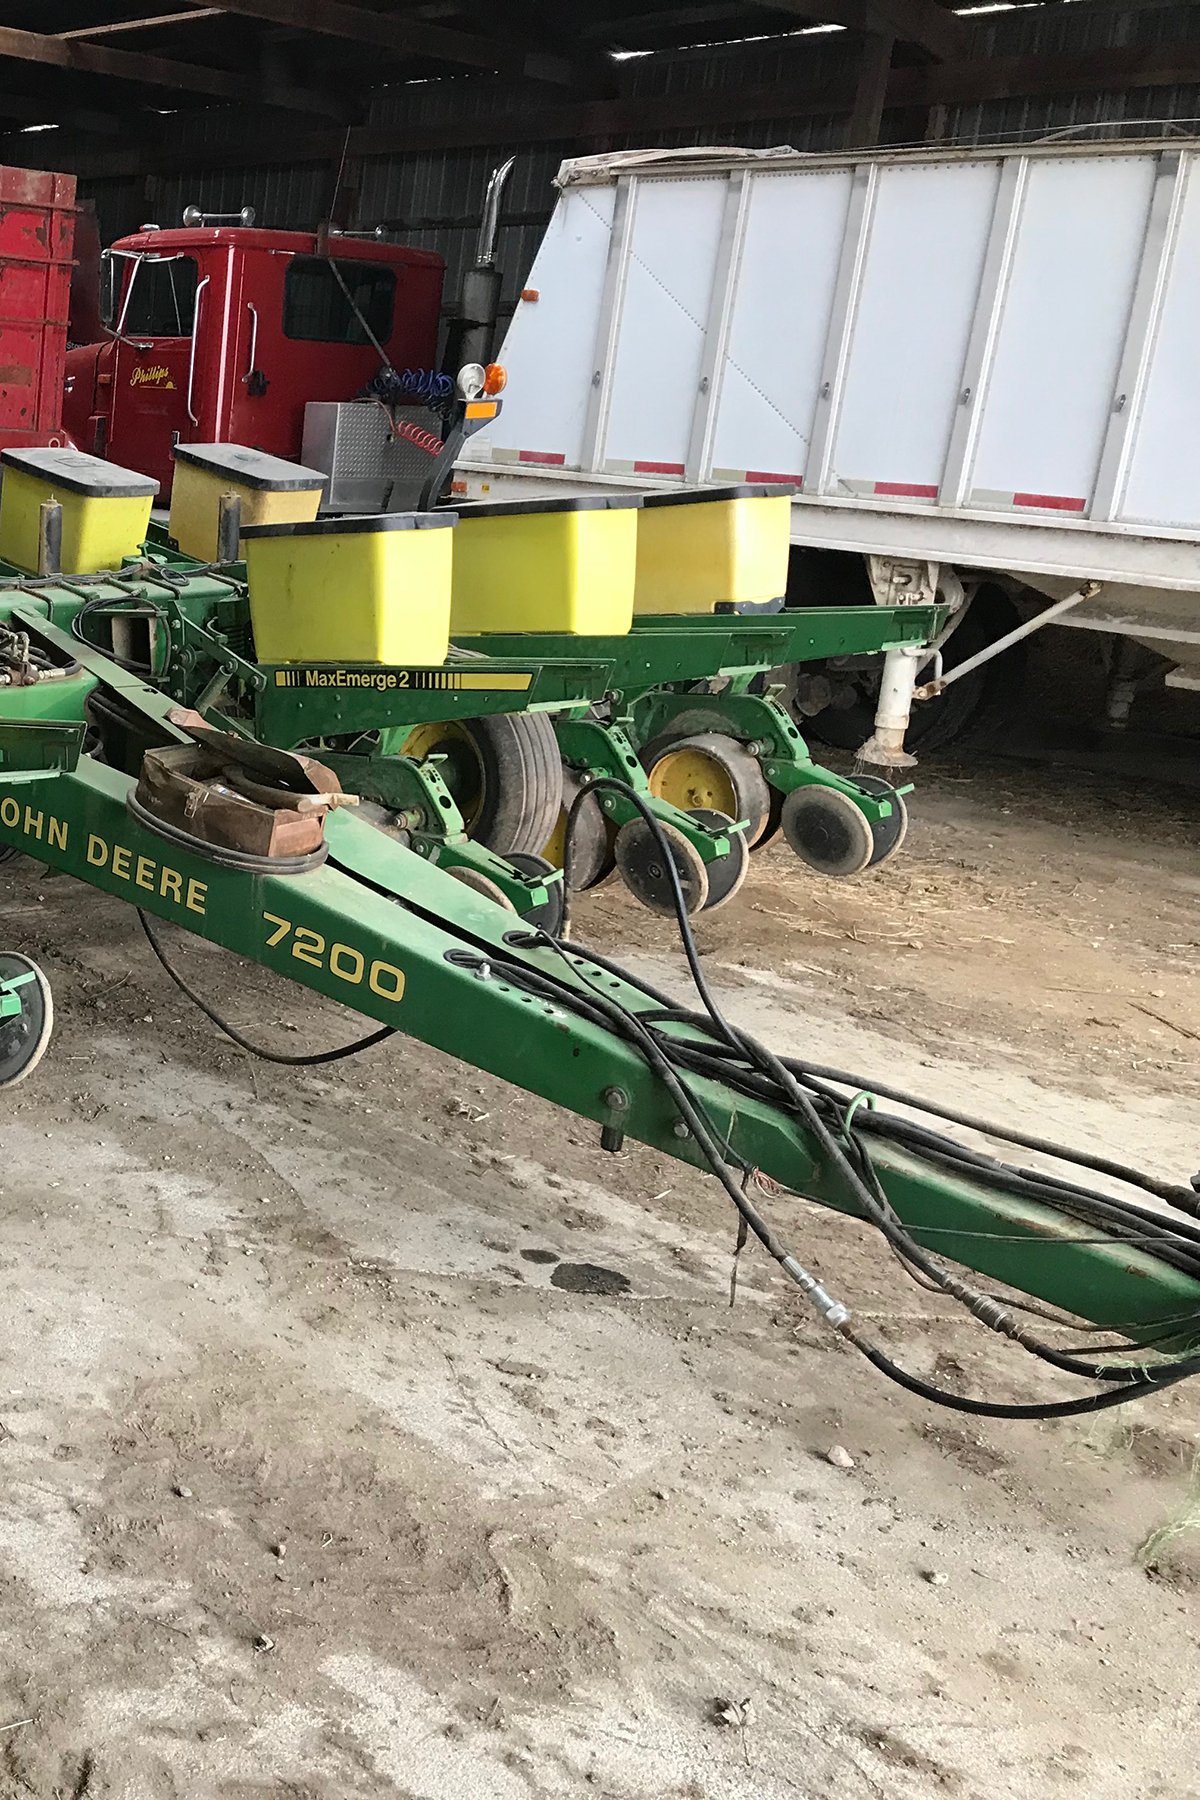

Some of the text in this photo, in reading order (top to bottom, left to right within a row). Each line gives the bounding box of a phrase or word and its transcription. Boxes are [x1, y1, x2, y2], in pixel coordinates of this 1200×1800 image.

[129, 365, 169, 387] Phillips
[86, 833, 208, 915] DEERE
[262, 910, 406, 1003] 7200
